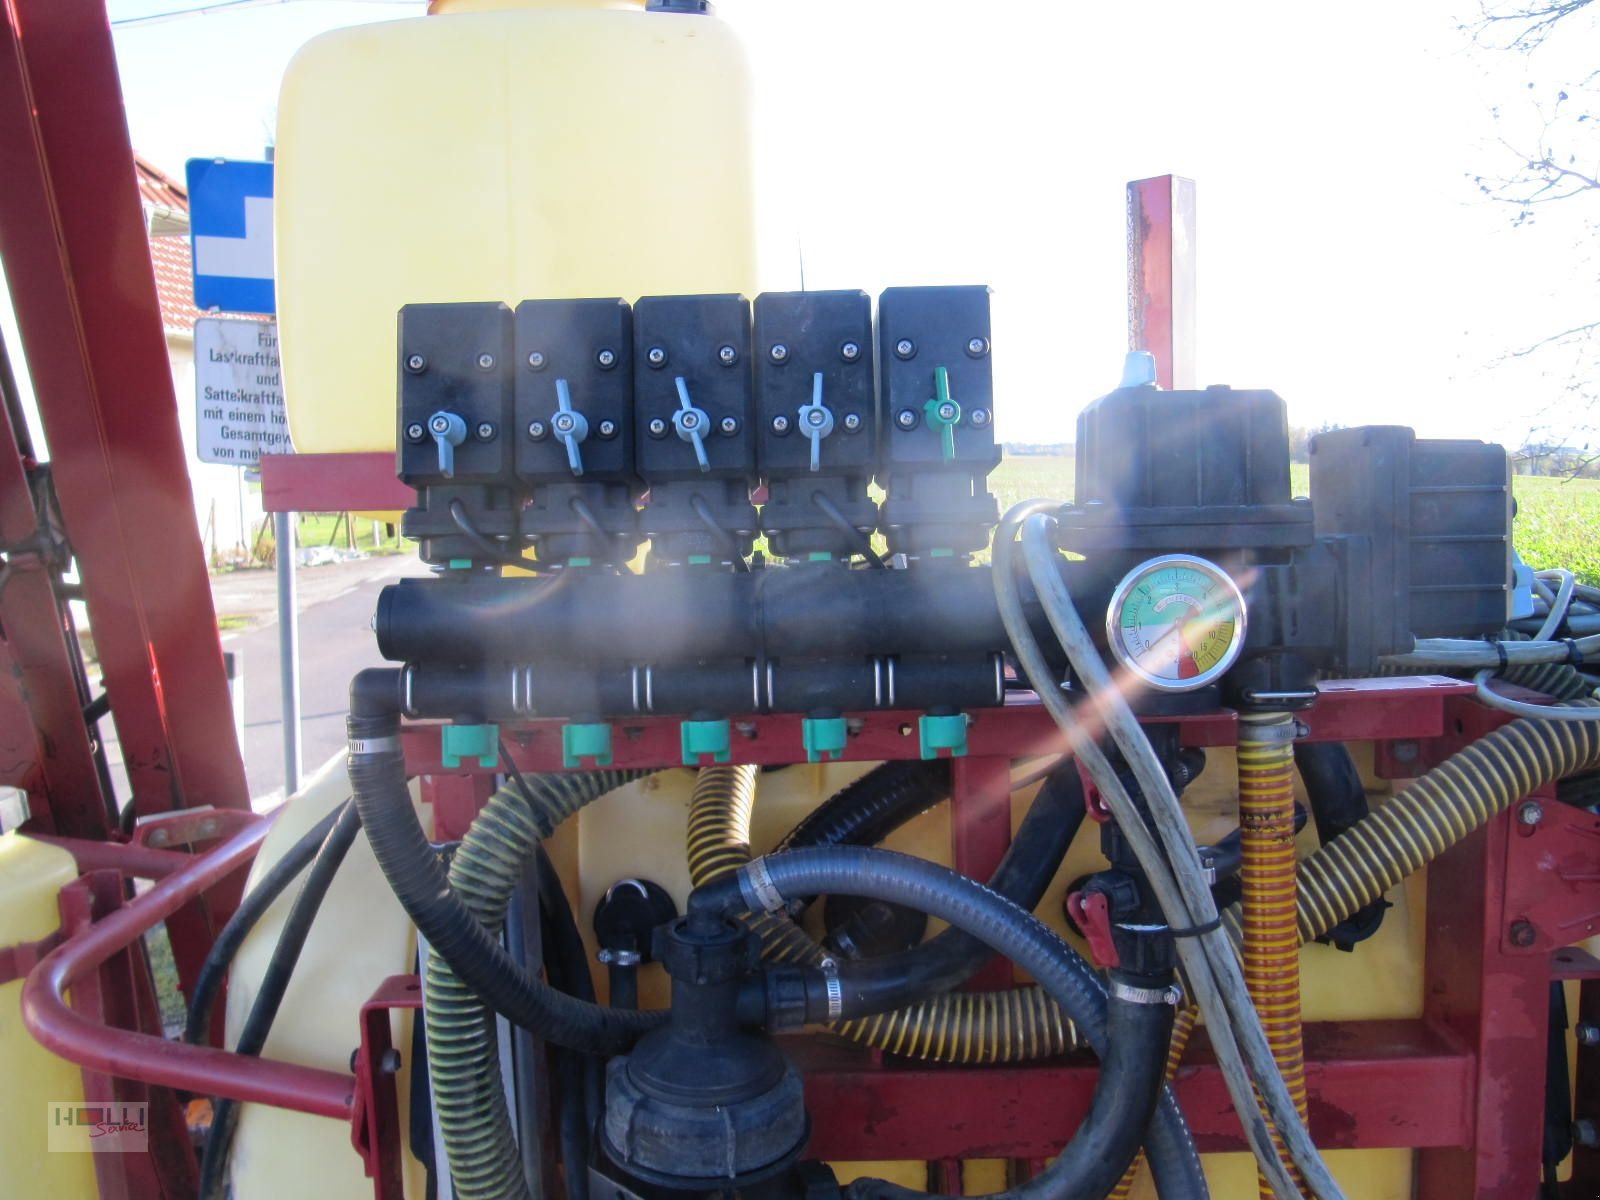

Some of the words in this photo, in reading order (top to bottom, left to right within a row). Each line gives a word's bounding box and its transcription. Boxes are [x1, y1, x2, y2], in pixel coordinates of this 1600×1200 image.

[256, 373, 279, 387] und
[204, 406, 223, 420] mit
[229, 407, 265, 424] einem
[271, 410, 287, 424] hö
[213, 447, 234, 459] von
